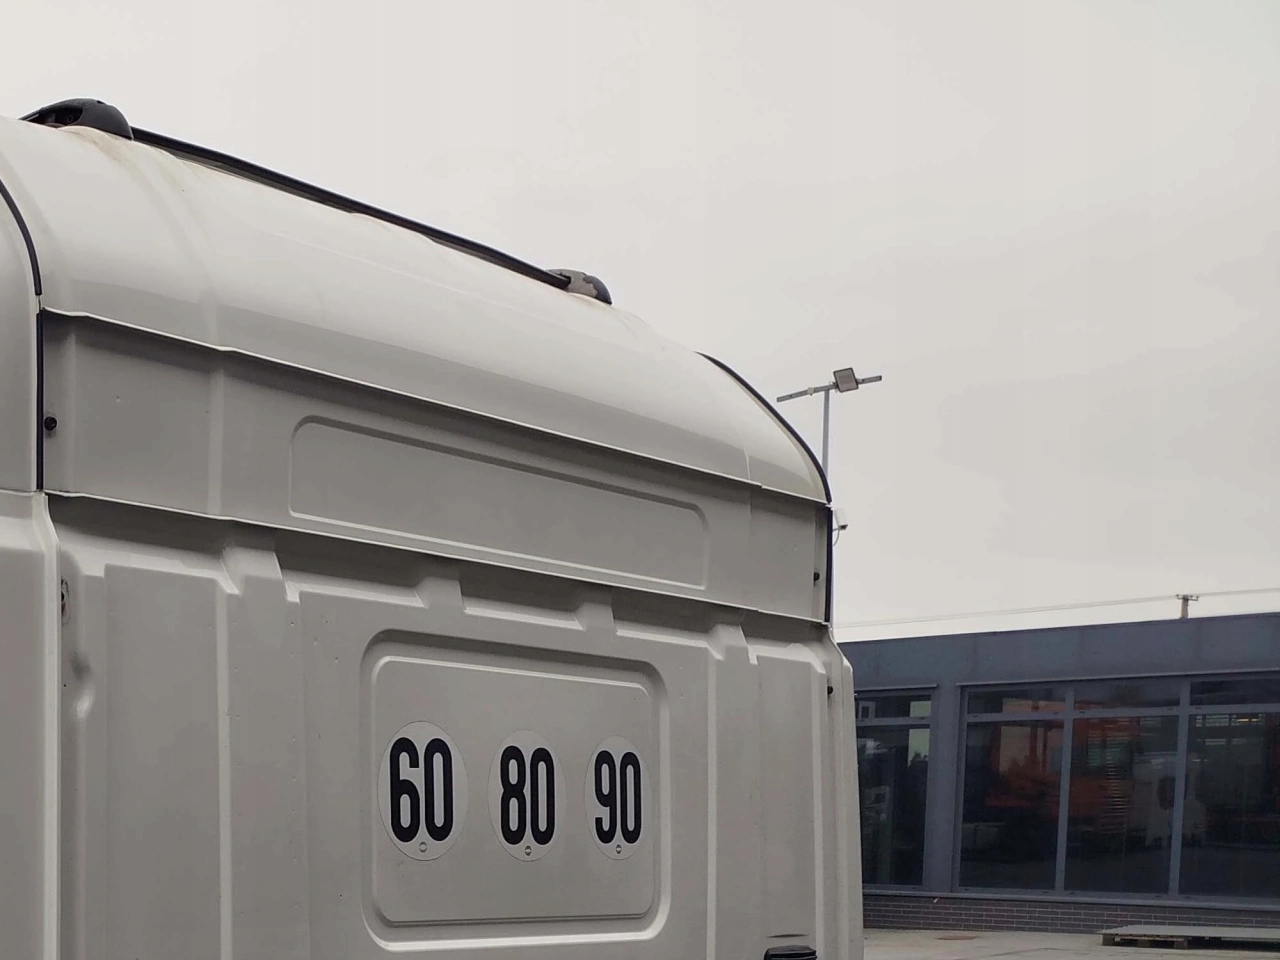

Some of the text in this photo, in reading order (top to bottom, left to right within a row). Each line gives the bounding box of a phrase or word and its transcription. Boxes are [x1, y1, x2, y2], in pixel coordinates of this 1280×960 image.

[390, 736, 454, 843] 60
[500, 745, 555, 845] 80
[594, 750, 642, 845] 90
